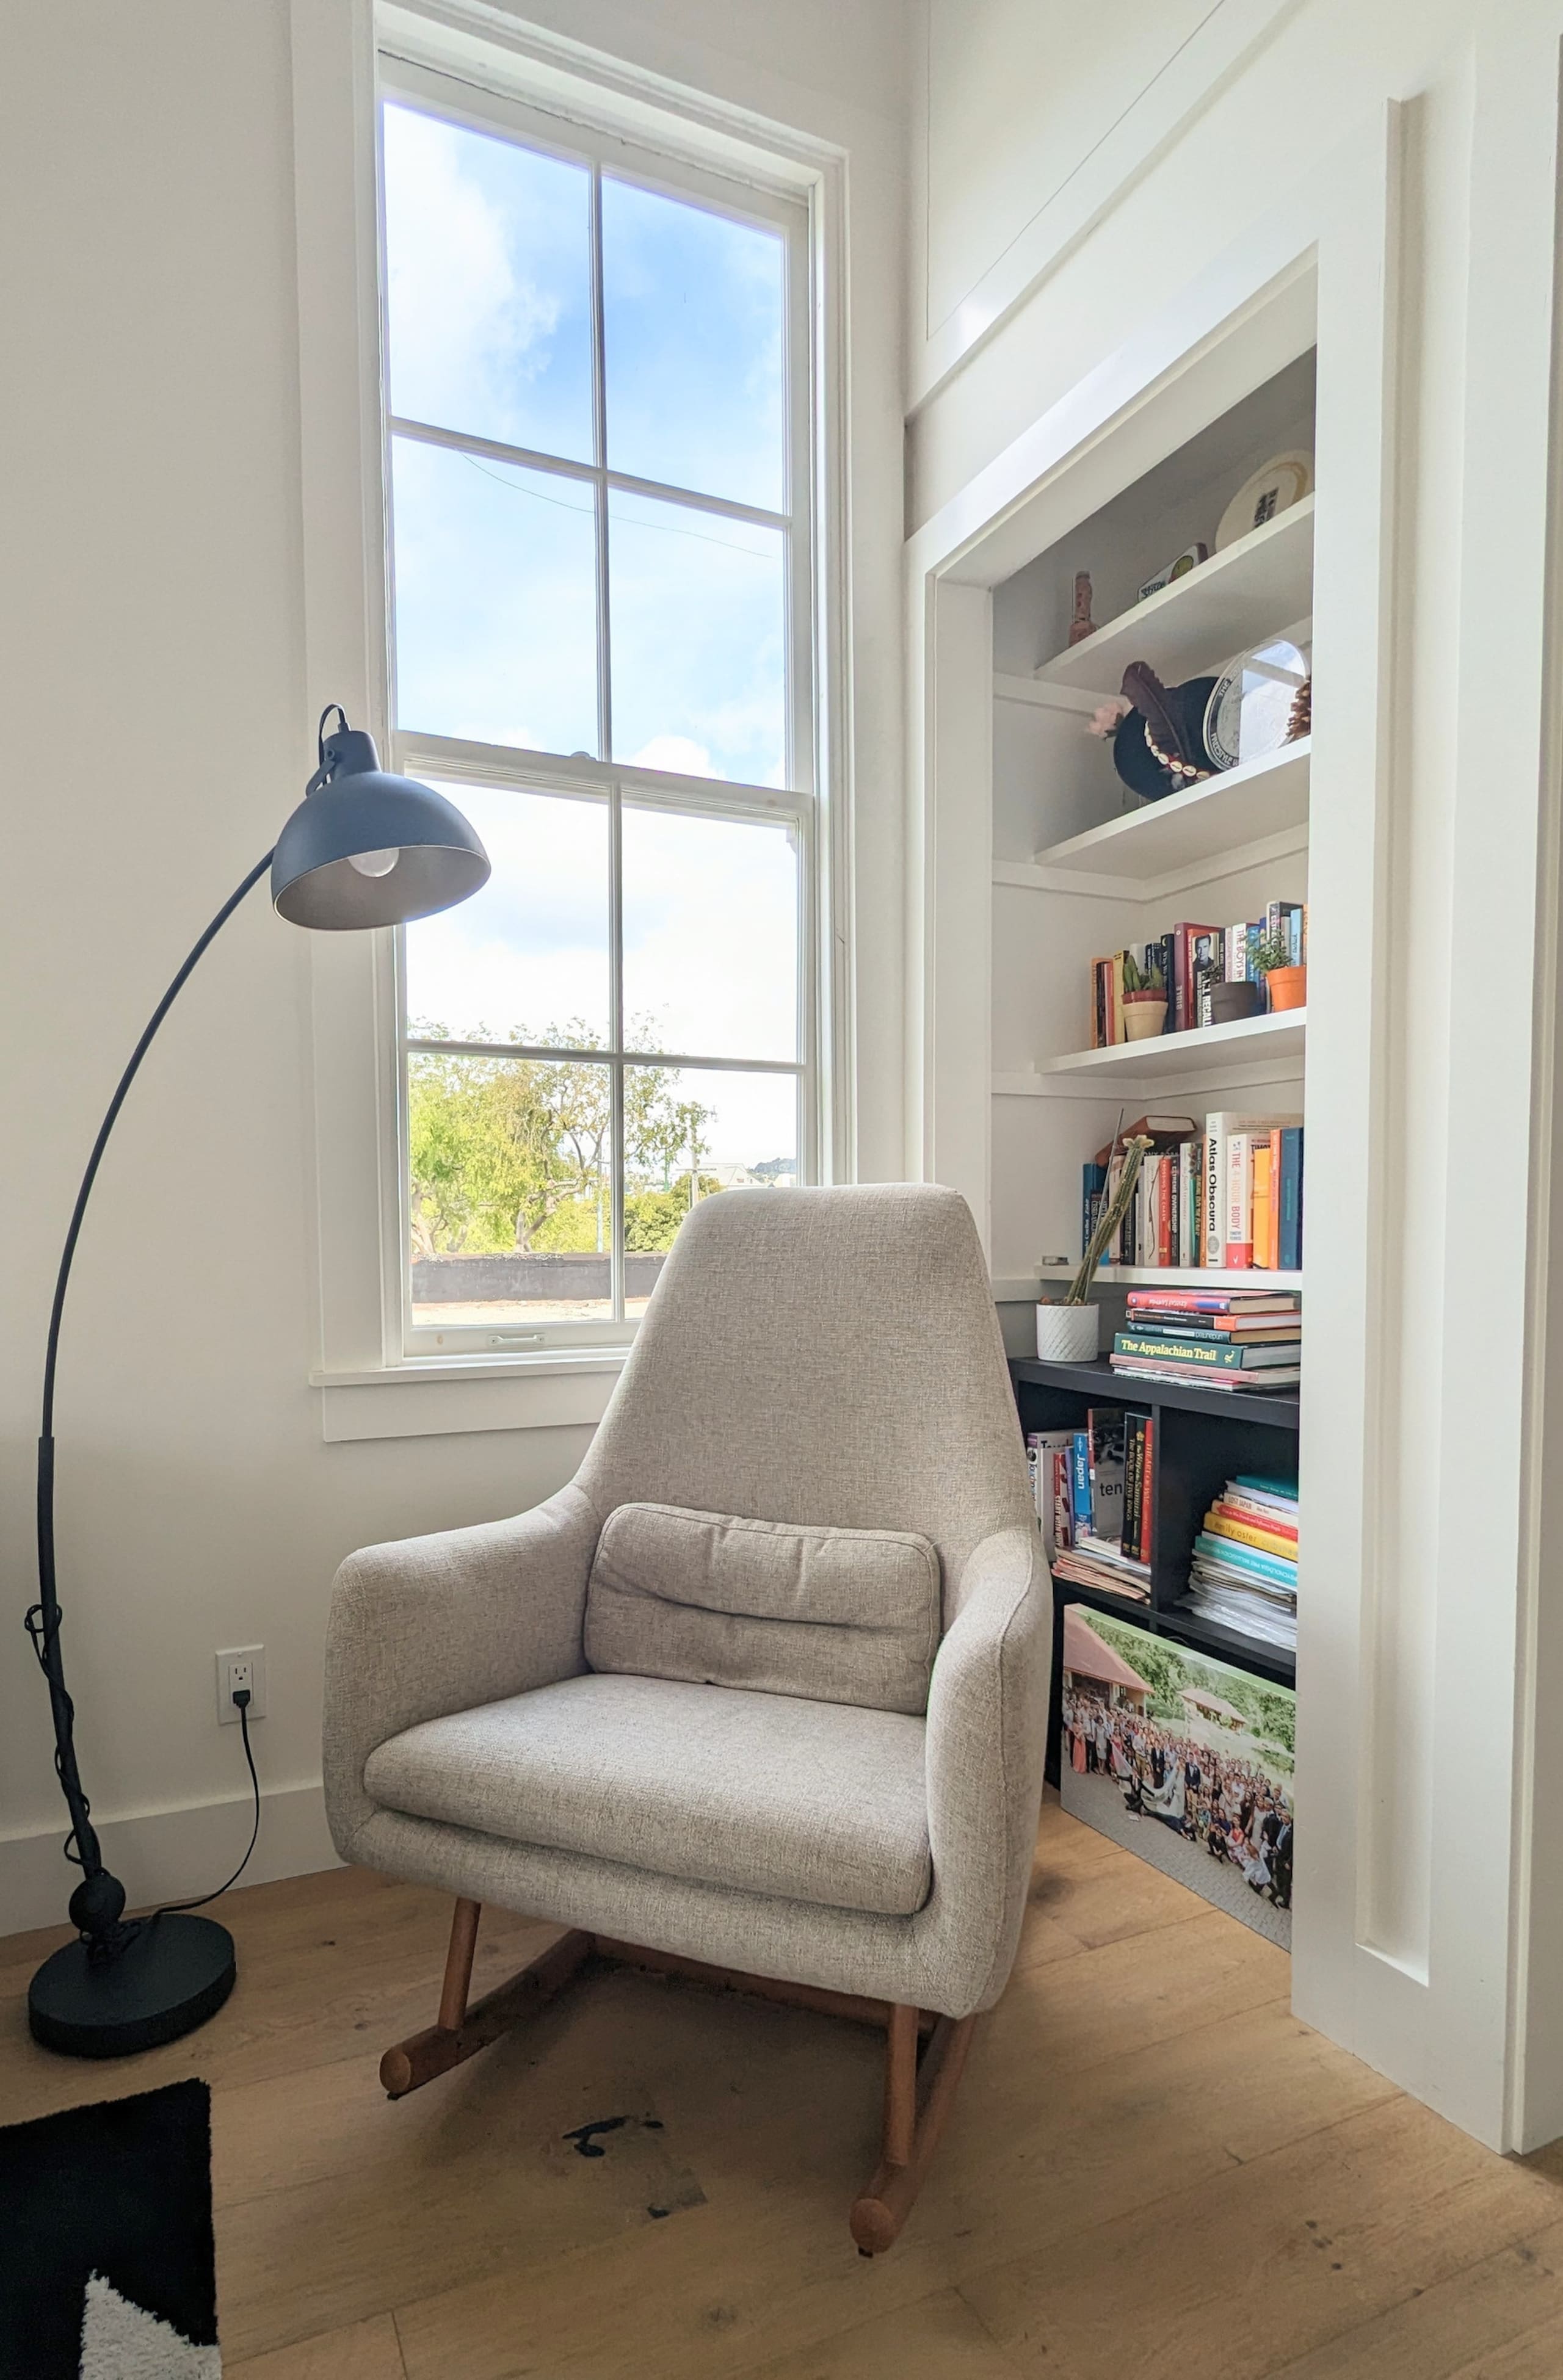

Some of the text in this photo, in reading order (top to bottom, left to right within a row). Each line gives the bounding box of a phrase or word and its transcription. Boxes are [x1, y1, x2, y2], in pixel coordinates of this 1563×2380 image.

[1202, 996, 1212, 1027] RECALL
[1231, 1153, 1241, 1168] THE
[1231, 1170, 1241, 1203] 4-HOUR
[1231, 1206, 1241, 1229] BODY
[1122, 1339, 1217, 1361] The Appalachian Trail
[1077, 1454, 1086, 1489] Japan
[1100, 1483, 1122, 1497] ten
[1228, 1496, 1238, 1505] LOST
[1239, 1499, 1252, 1510] JAPAN
[1214, 1521, 1235, 1535] emily
[1236, 1531, 1257, 1543] oster
